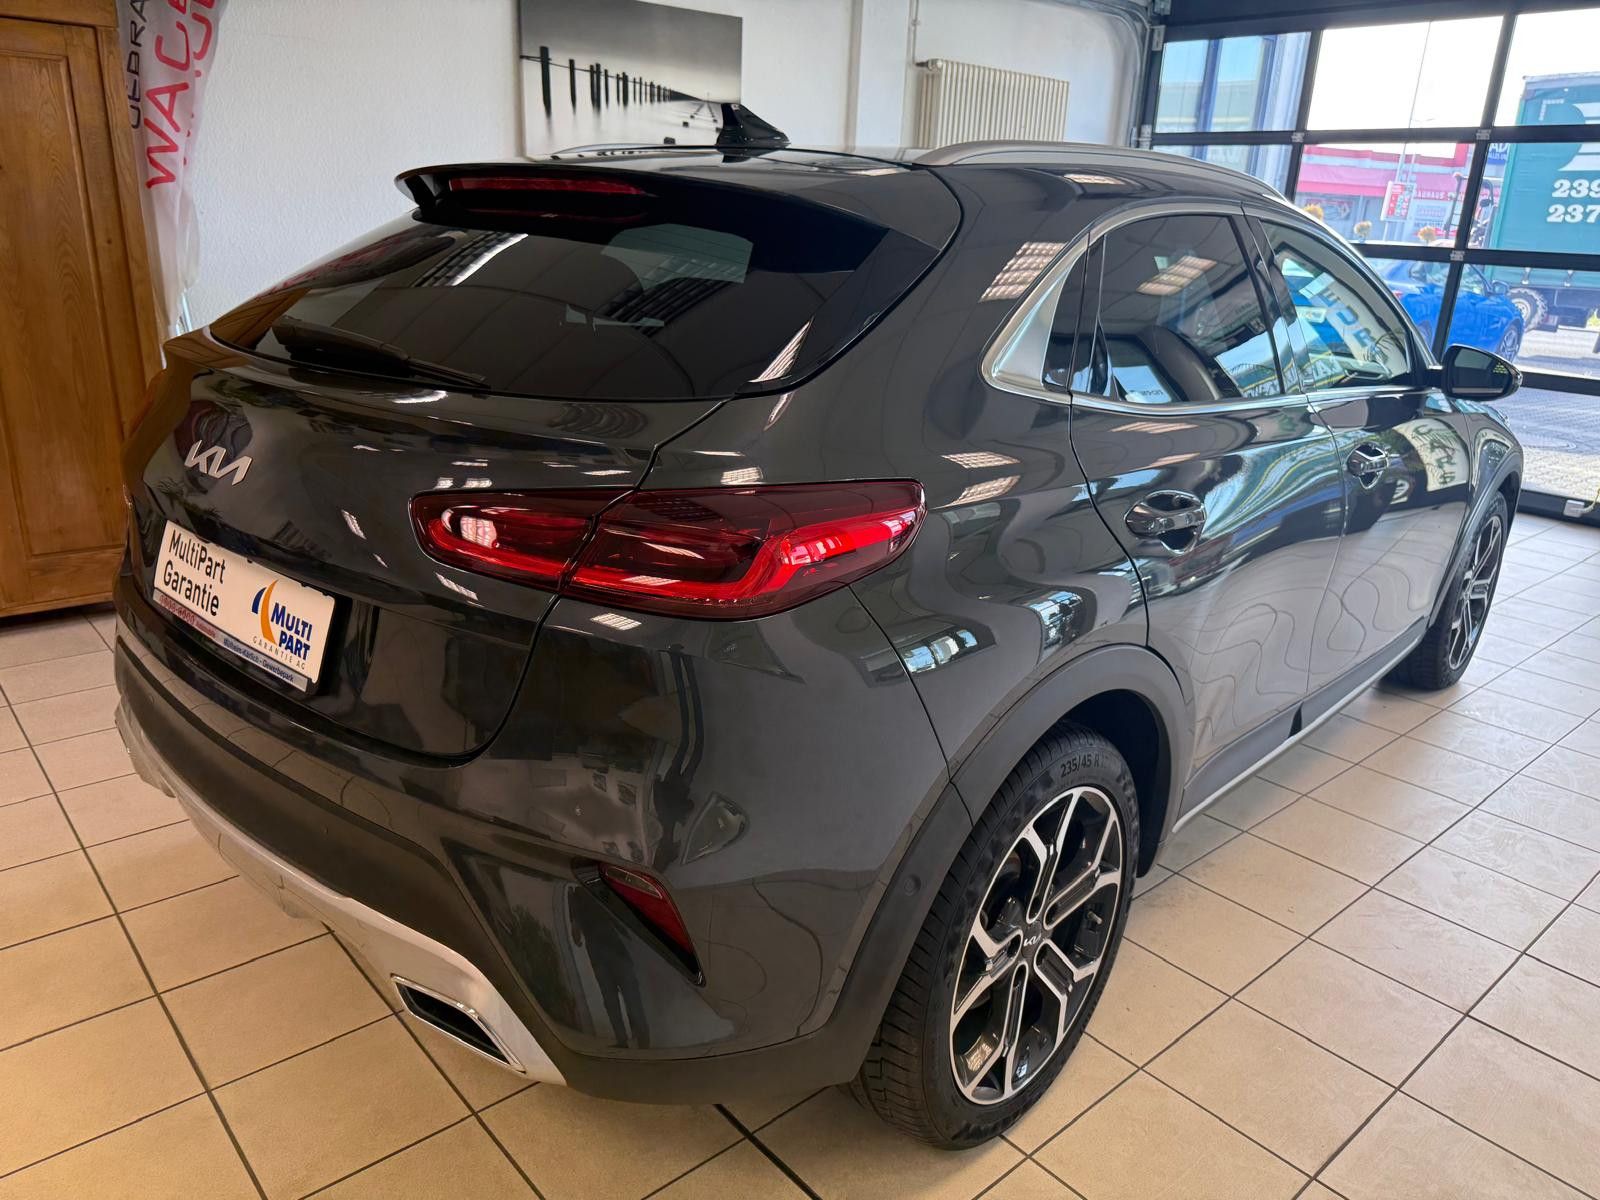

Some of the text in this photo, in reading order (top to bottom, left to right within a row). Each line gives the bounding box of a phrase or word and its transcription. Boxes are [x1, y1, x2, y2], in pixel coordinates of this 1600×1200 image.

[169, 529, 226, 584] MultiPart
[163, 560, 219, 616] Garantie
[252, 635, 293, 664] GARANTIE
[278, 630, 311, 660] PART
